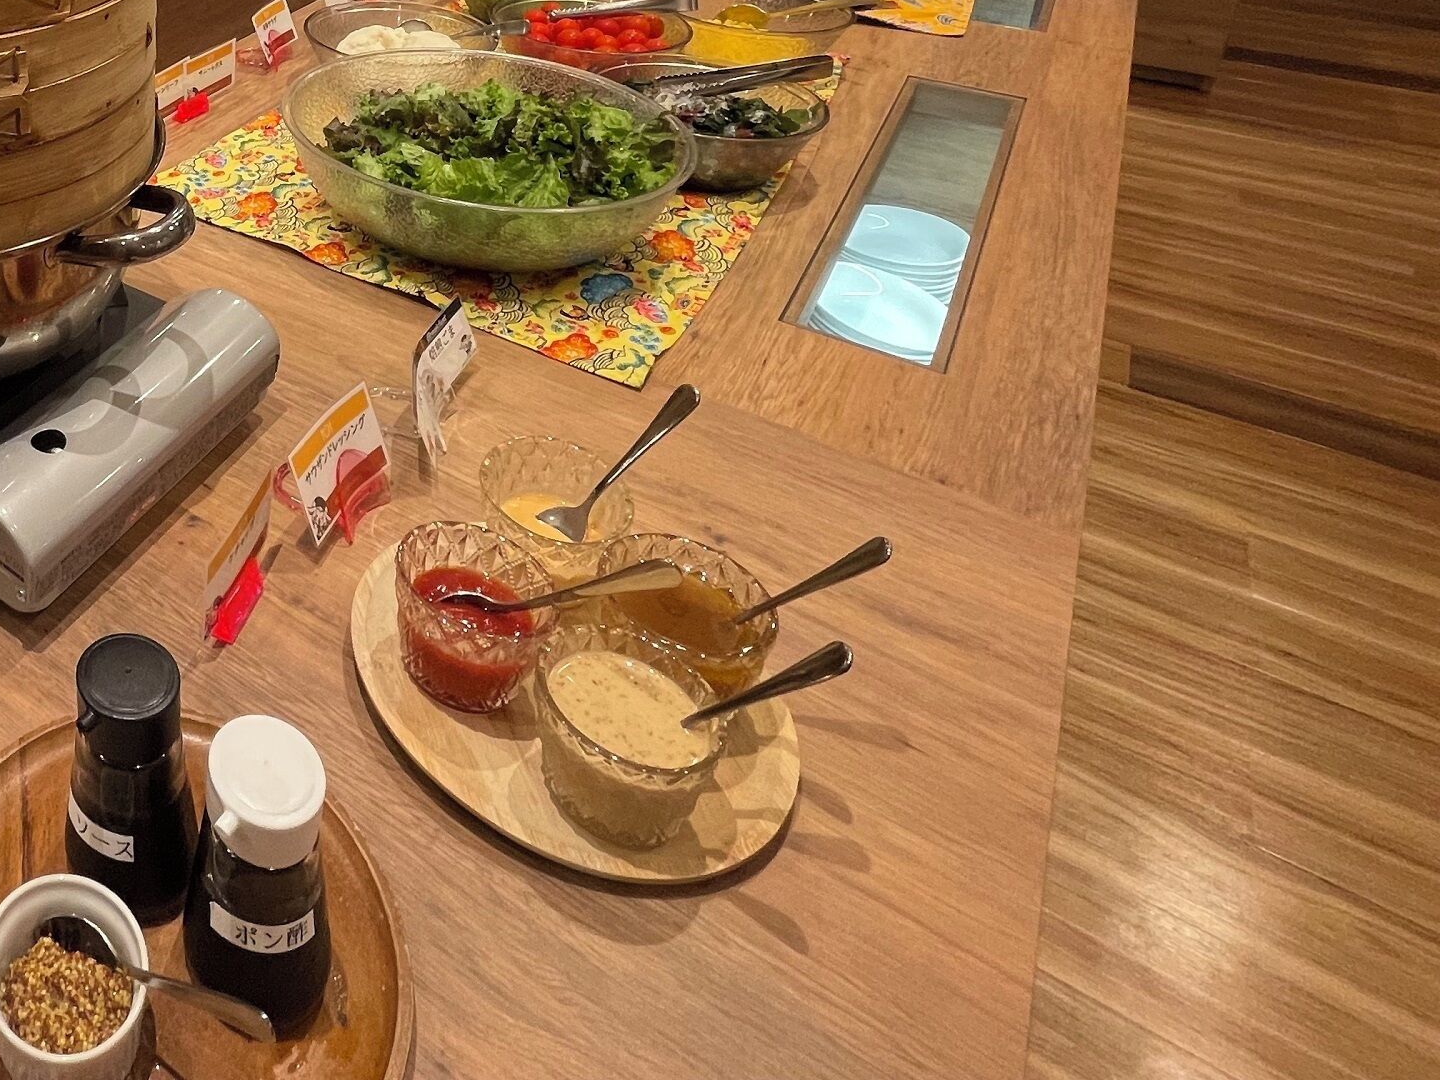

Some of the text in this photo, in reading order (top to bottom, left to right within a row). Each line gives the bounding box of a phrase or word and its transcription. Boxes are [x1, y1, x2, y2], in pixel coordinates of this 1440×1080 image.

[77, 813, 133, 858] ソース
[233, 921, 309, 949] ポン酢
